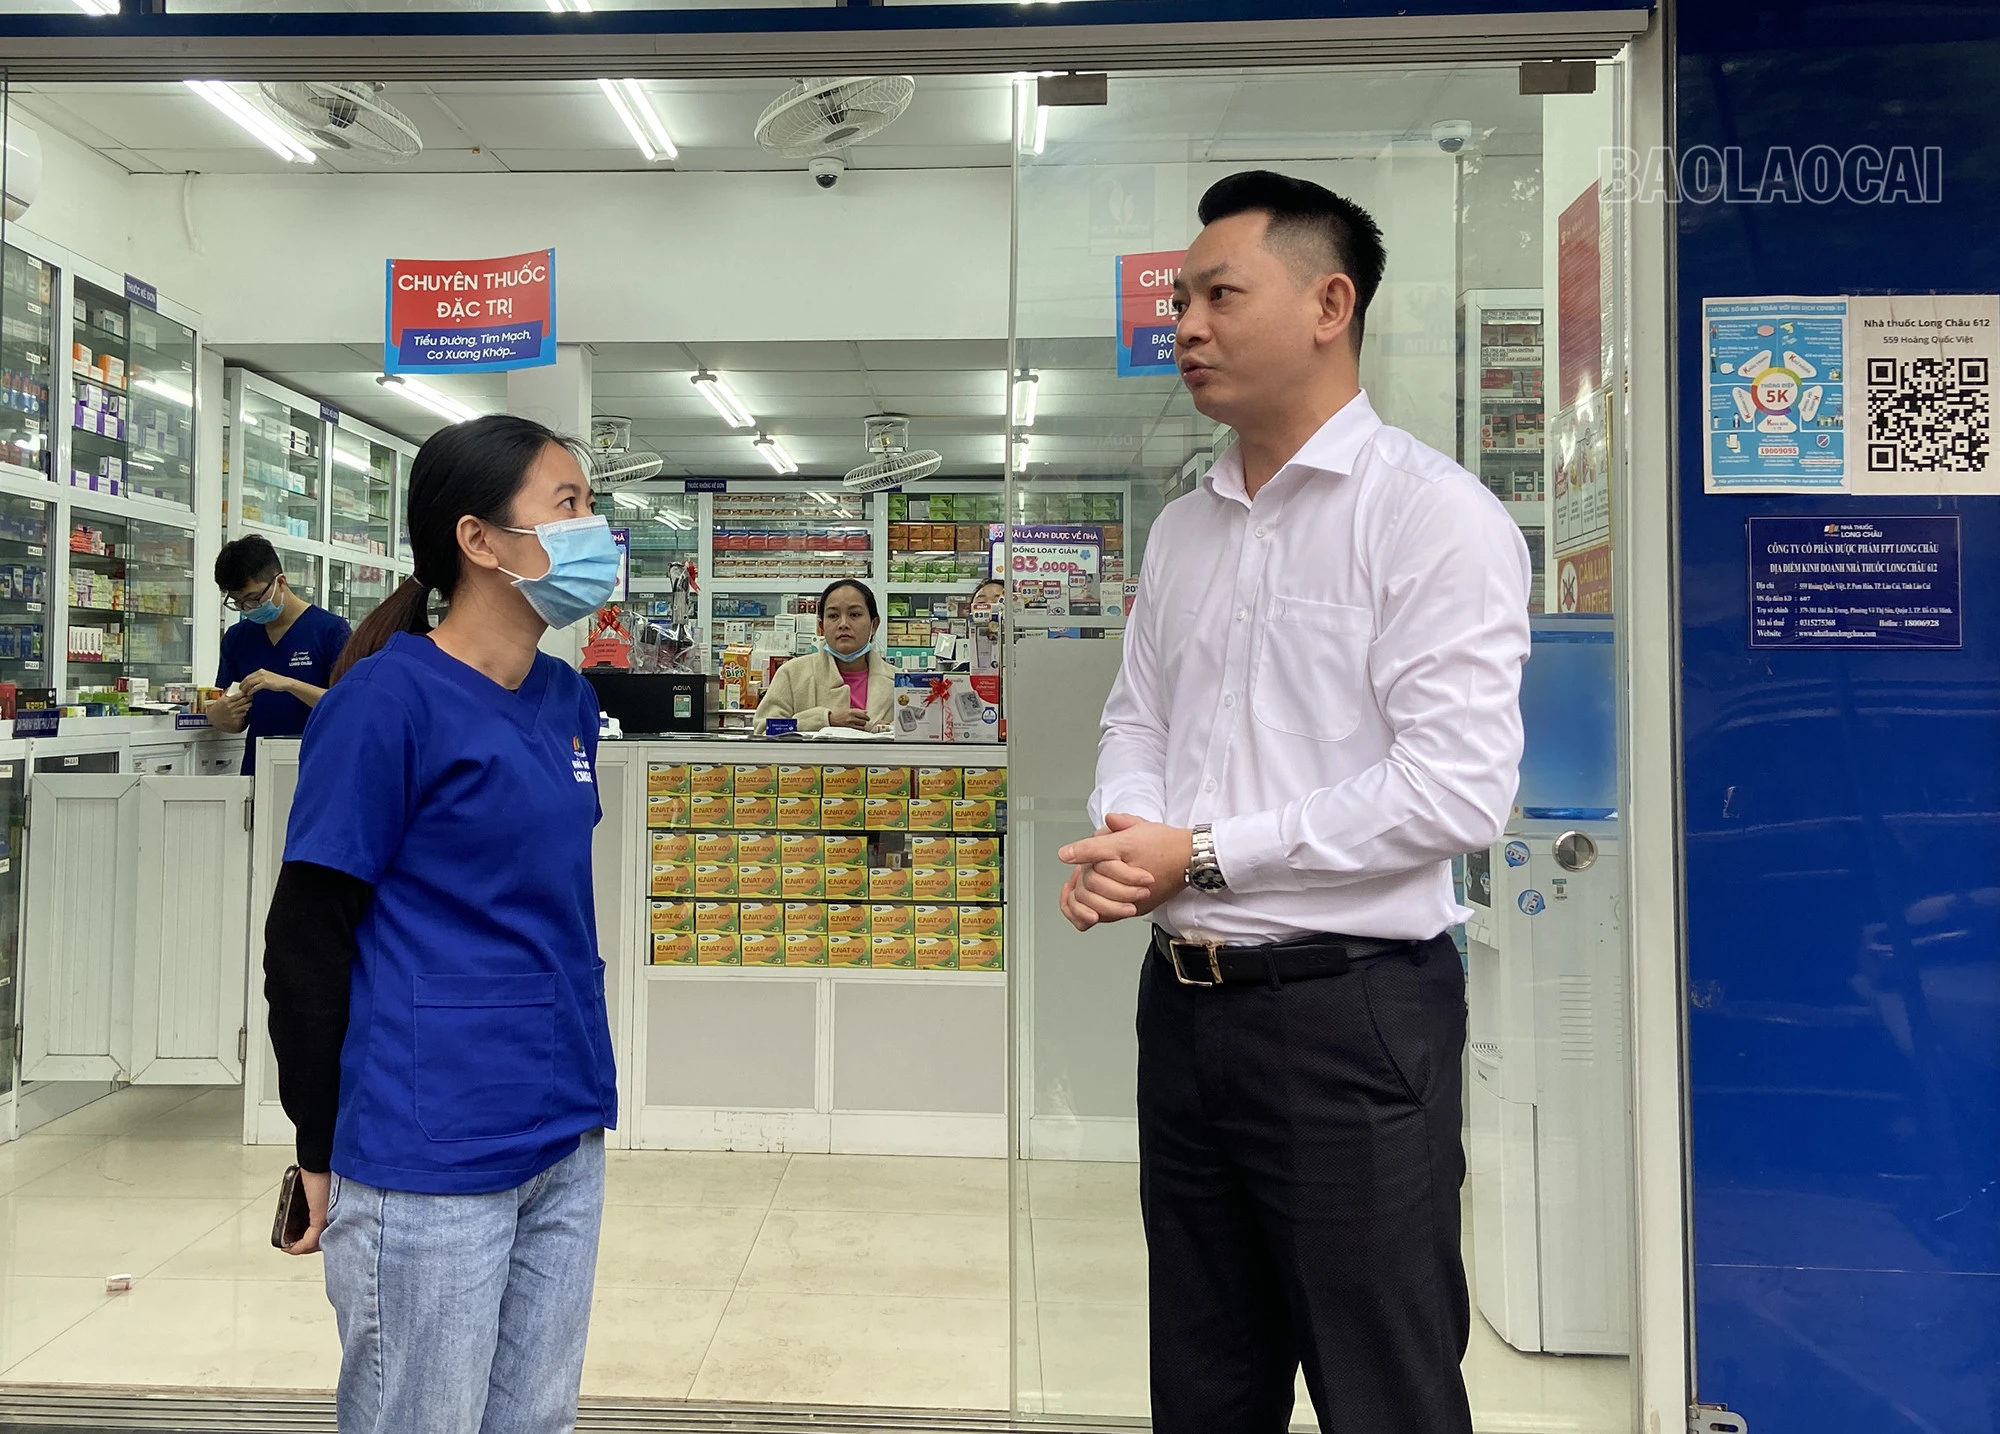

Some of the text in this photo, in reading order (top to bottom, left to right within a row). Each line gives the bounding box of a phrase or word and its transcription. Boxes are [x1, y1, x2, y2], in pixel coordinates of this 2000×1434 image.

[398, 261, 546, 291] CHUYÊN THUỐC
[436, 297, 513, 323] ĐẶC TRỊ
[1864, 319, 1990, 329] Nhà thuốc Long Châu 612
[413, 329, 531, 347] Tiểu Đường, Tim Mạch,
[1901, 336, 1930, 345] Hoàng
[1931, 335, 1954, 345] Quốc
[1955, 336, 1974, 344] Việt
[427, 349, 443, 360] Cơ
[445, 348, 481, 361] Xương
[1766, 390, 1789, 403] 5K
[1760, 447, 1797, 455] 19009095
[1022, 529, 1033, 539] LÀ
[1034, 531, 1050, 539] ANH
[1050, 530, 1070, 541] ĐƯỢC
[1083, 530, 1098, 540] NHÀ
[1012, 543, 1035, 554] ĐỒNG
[1058, 545, 1079, 555] GIẢM
[1767, 542, 1789, 553] CÔNG
[1789, 545, 1800, 553] TY
[1881, 545, 1894, 553] FPT
[1895, 545, 1917, 553] LONG
[1917, 542, 1939, 553] CHÂU
[1801, 564, 1819, 573] KINH
[1820, 564, 1845, 573] DOANH
[1846, 560, 1860, 573] NHÀ
[1861, 560, 1886, 573] THUỐC
[1886, 564, 1906, 573] LONG
[1906, 560, 1927, 573] CHÂU
[1927, 564, 1938, 573] 612
